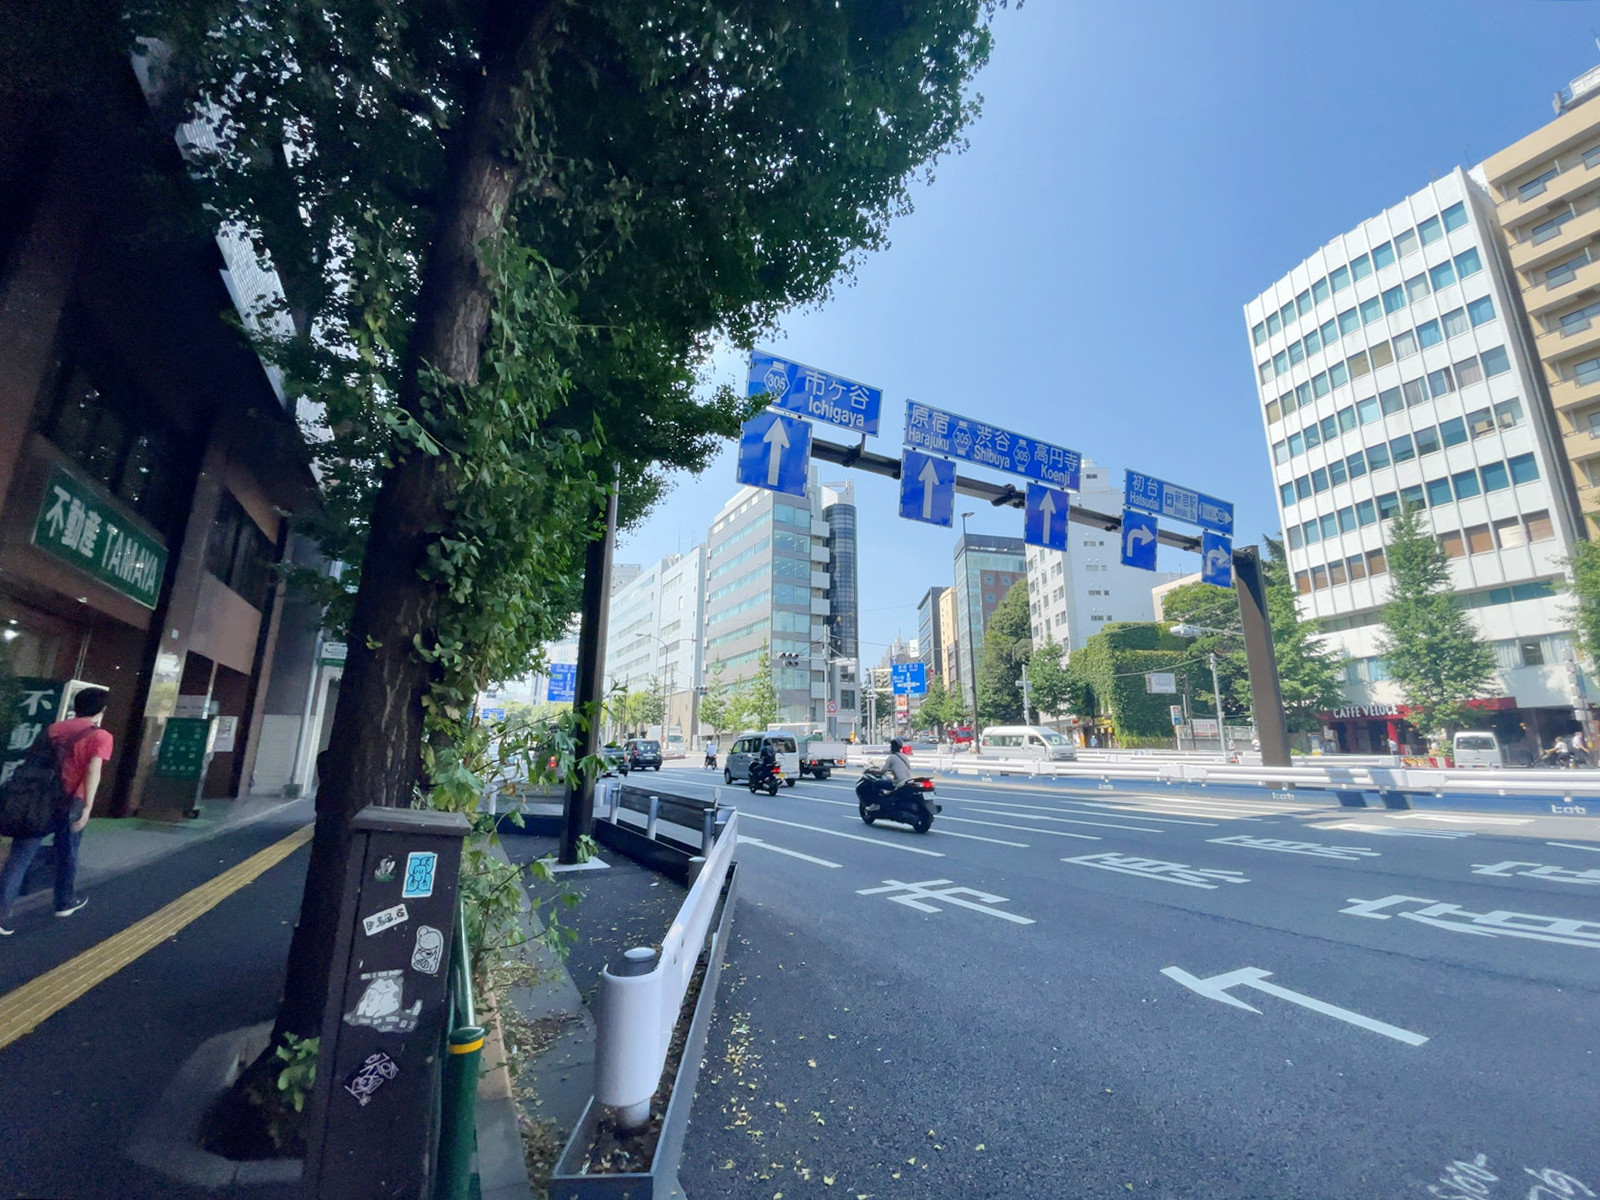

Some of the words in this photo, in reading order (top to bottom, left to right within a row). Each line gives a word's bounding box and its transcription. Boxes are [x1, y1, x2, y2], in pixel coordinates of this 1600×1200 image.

[767, 373, 786, 391] 305
[808, 395, 865, 428] Ichigaya
[910, 404, 950, 435] 原宿
[908, 425, 950, 451] Harajuku
[955, 431, 969, 446] 305
[975, 424, 1011, 452] 渋谷
[973, 444, 1011, 469] Shibuya
[1015, 449, 1029, 463] 305
[1034, 442, 1079, 472] 高円寺
[1040, 463, 1071, 487] Koenji
[1131, 473, 1159, 497] 初台
[46, 485, 103, 558] 不動産
[101, 523, 158, 595] TAMAYA
[1361, 703, 1398, 716] VELOCE
[854, 879, 1038, 925] 市
